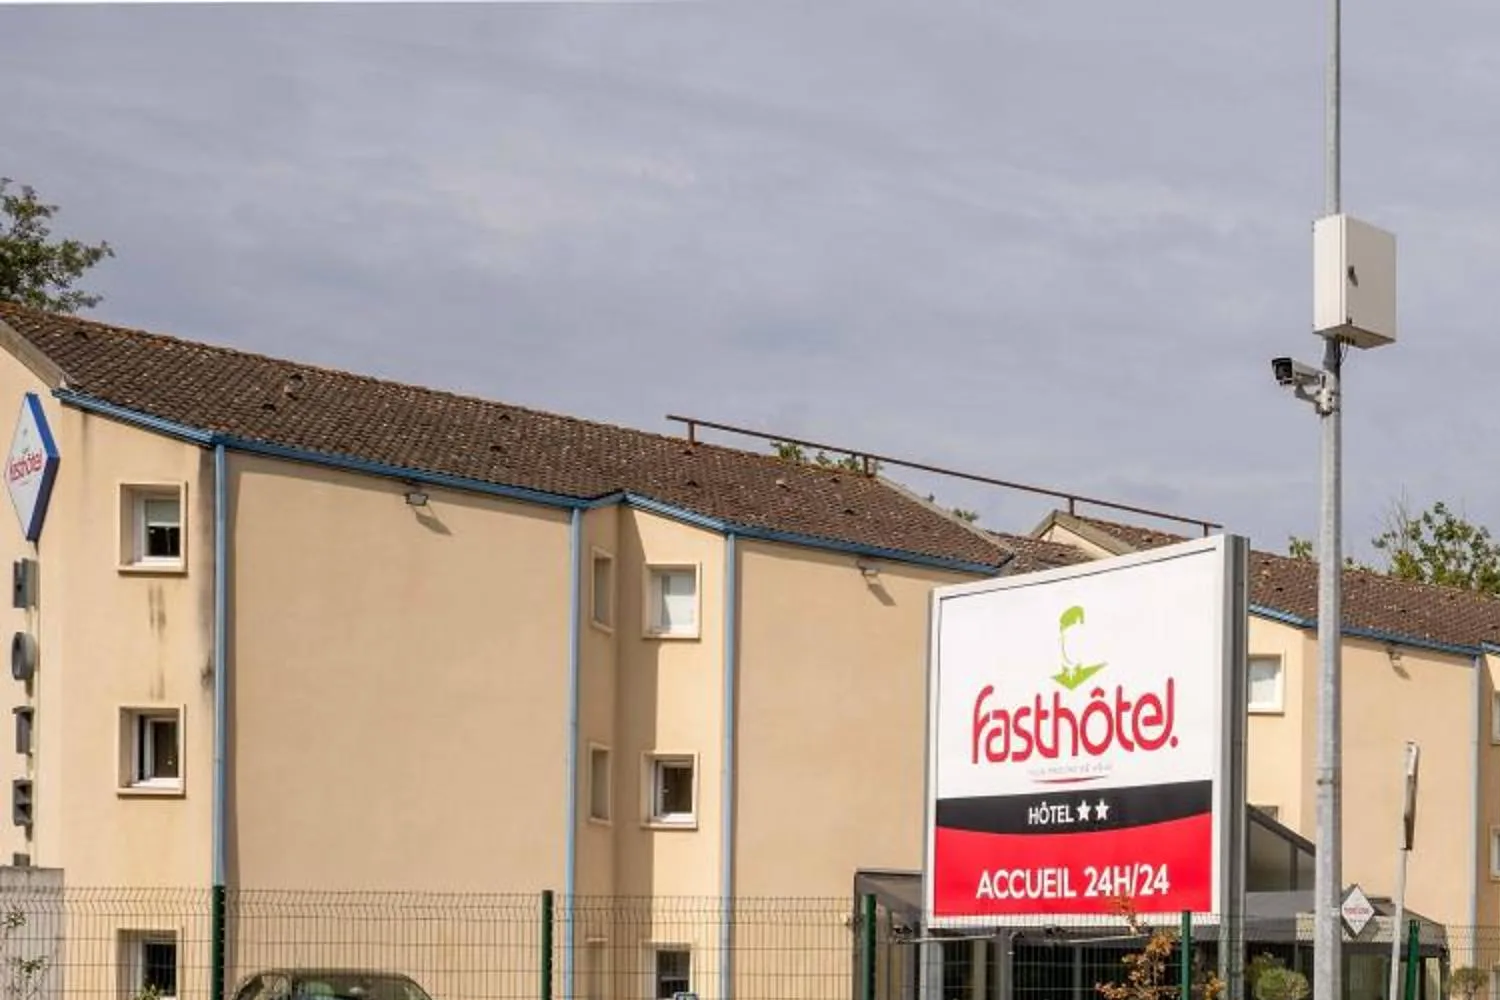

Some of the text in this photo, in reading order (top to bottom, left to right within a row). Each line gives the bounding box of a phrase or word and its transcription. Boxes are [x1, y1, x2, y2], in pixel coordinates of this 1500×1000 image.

[1028, 801, 1075, 825] HÔTEL
[975, 863, 1170, 899] ACCUEIL 24H/24
